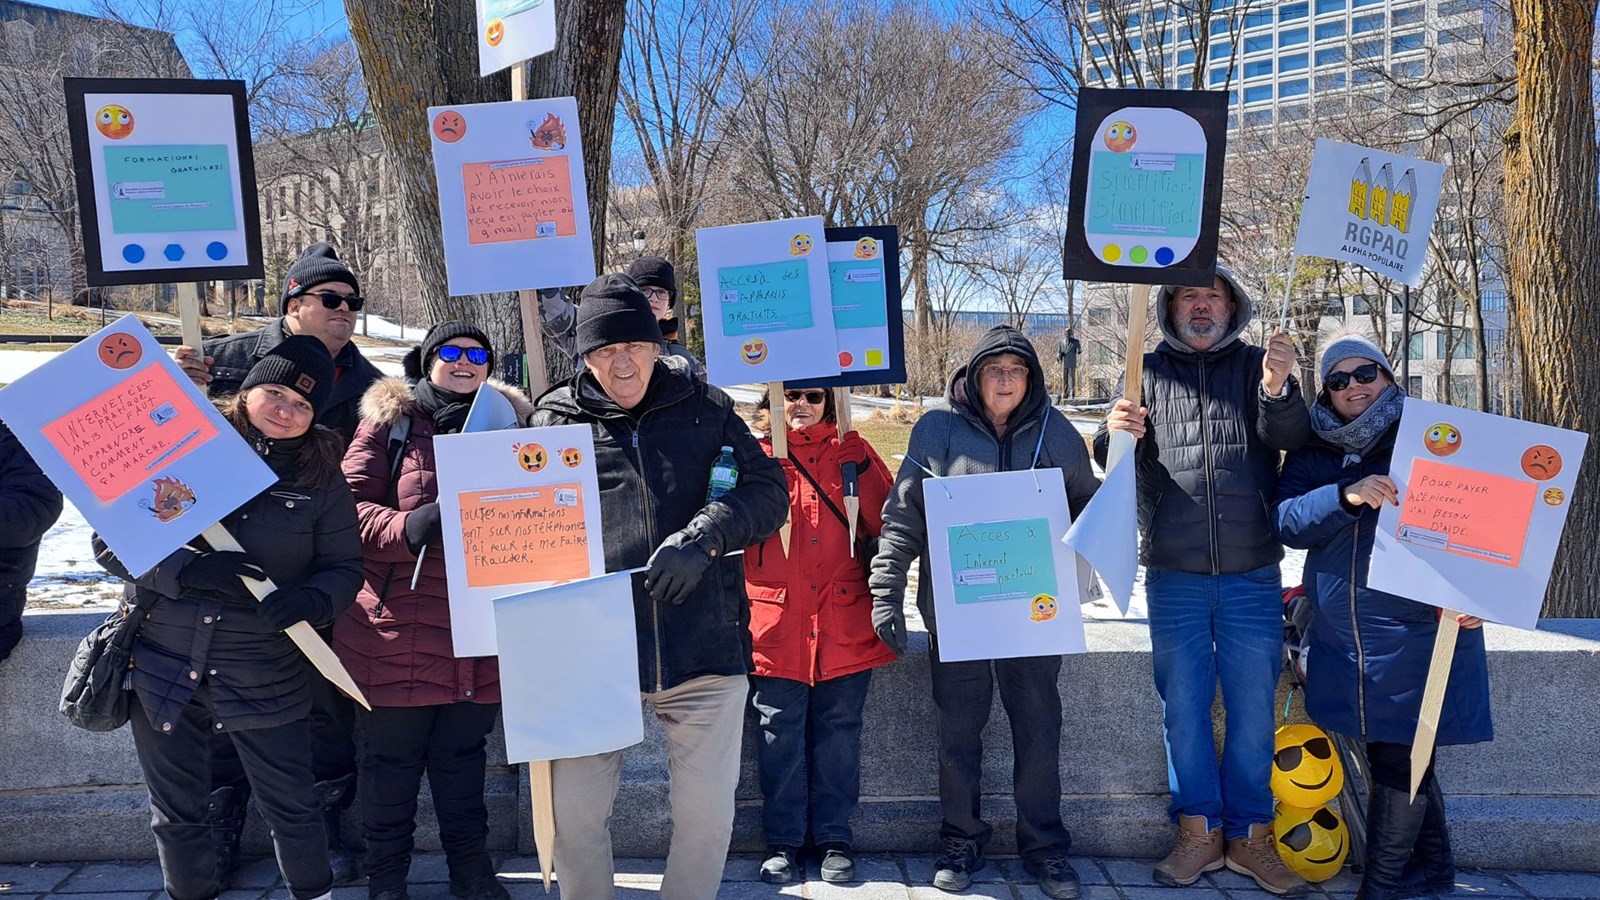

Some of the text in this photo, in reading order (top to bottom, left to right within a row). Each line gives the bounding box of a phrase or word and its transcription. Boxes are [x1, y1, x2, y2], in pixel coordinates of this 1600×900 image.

[512, 187, 522, 197] le
[527, 183, 560, 194] choix
[469, 197, 567, 214] de recevoir mon
[469, 217, 495, 227] reçu
[521, 209, 555, 223] papier
[1344, 221, 1409, 261] RGPAQ
[1341, 244, 1404, 273] ALPHA POPULAIRE
[782, 269, 800, 281] des
[57, 393, 124, 447] INTERNET
[98, 393, 147, 430] PRATIQUE
[73, 396, 156, 456] MAIS IL FAUT
[81, 424, 146, 469] APPRENDRE
[90, 436, 145, 478] COMMENT
[1419, 474, 1489, 494] POUR PAYER
[498, 511, 509, 519] nos
[1026, 526, 1036, 538] à
[464, 540, 484, 554] J'ai
[522, 540, 534, 550] de
[540, 539, 556, 549] me
[963, 552, 1007, 569] Internet
[997, 566, 1033, 594] partout
